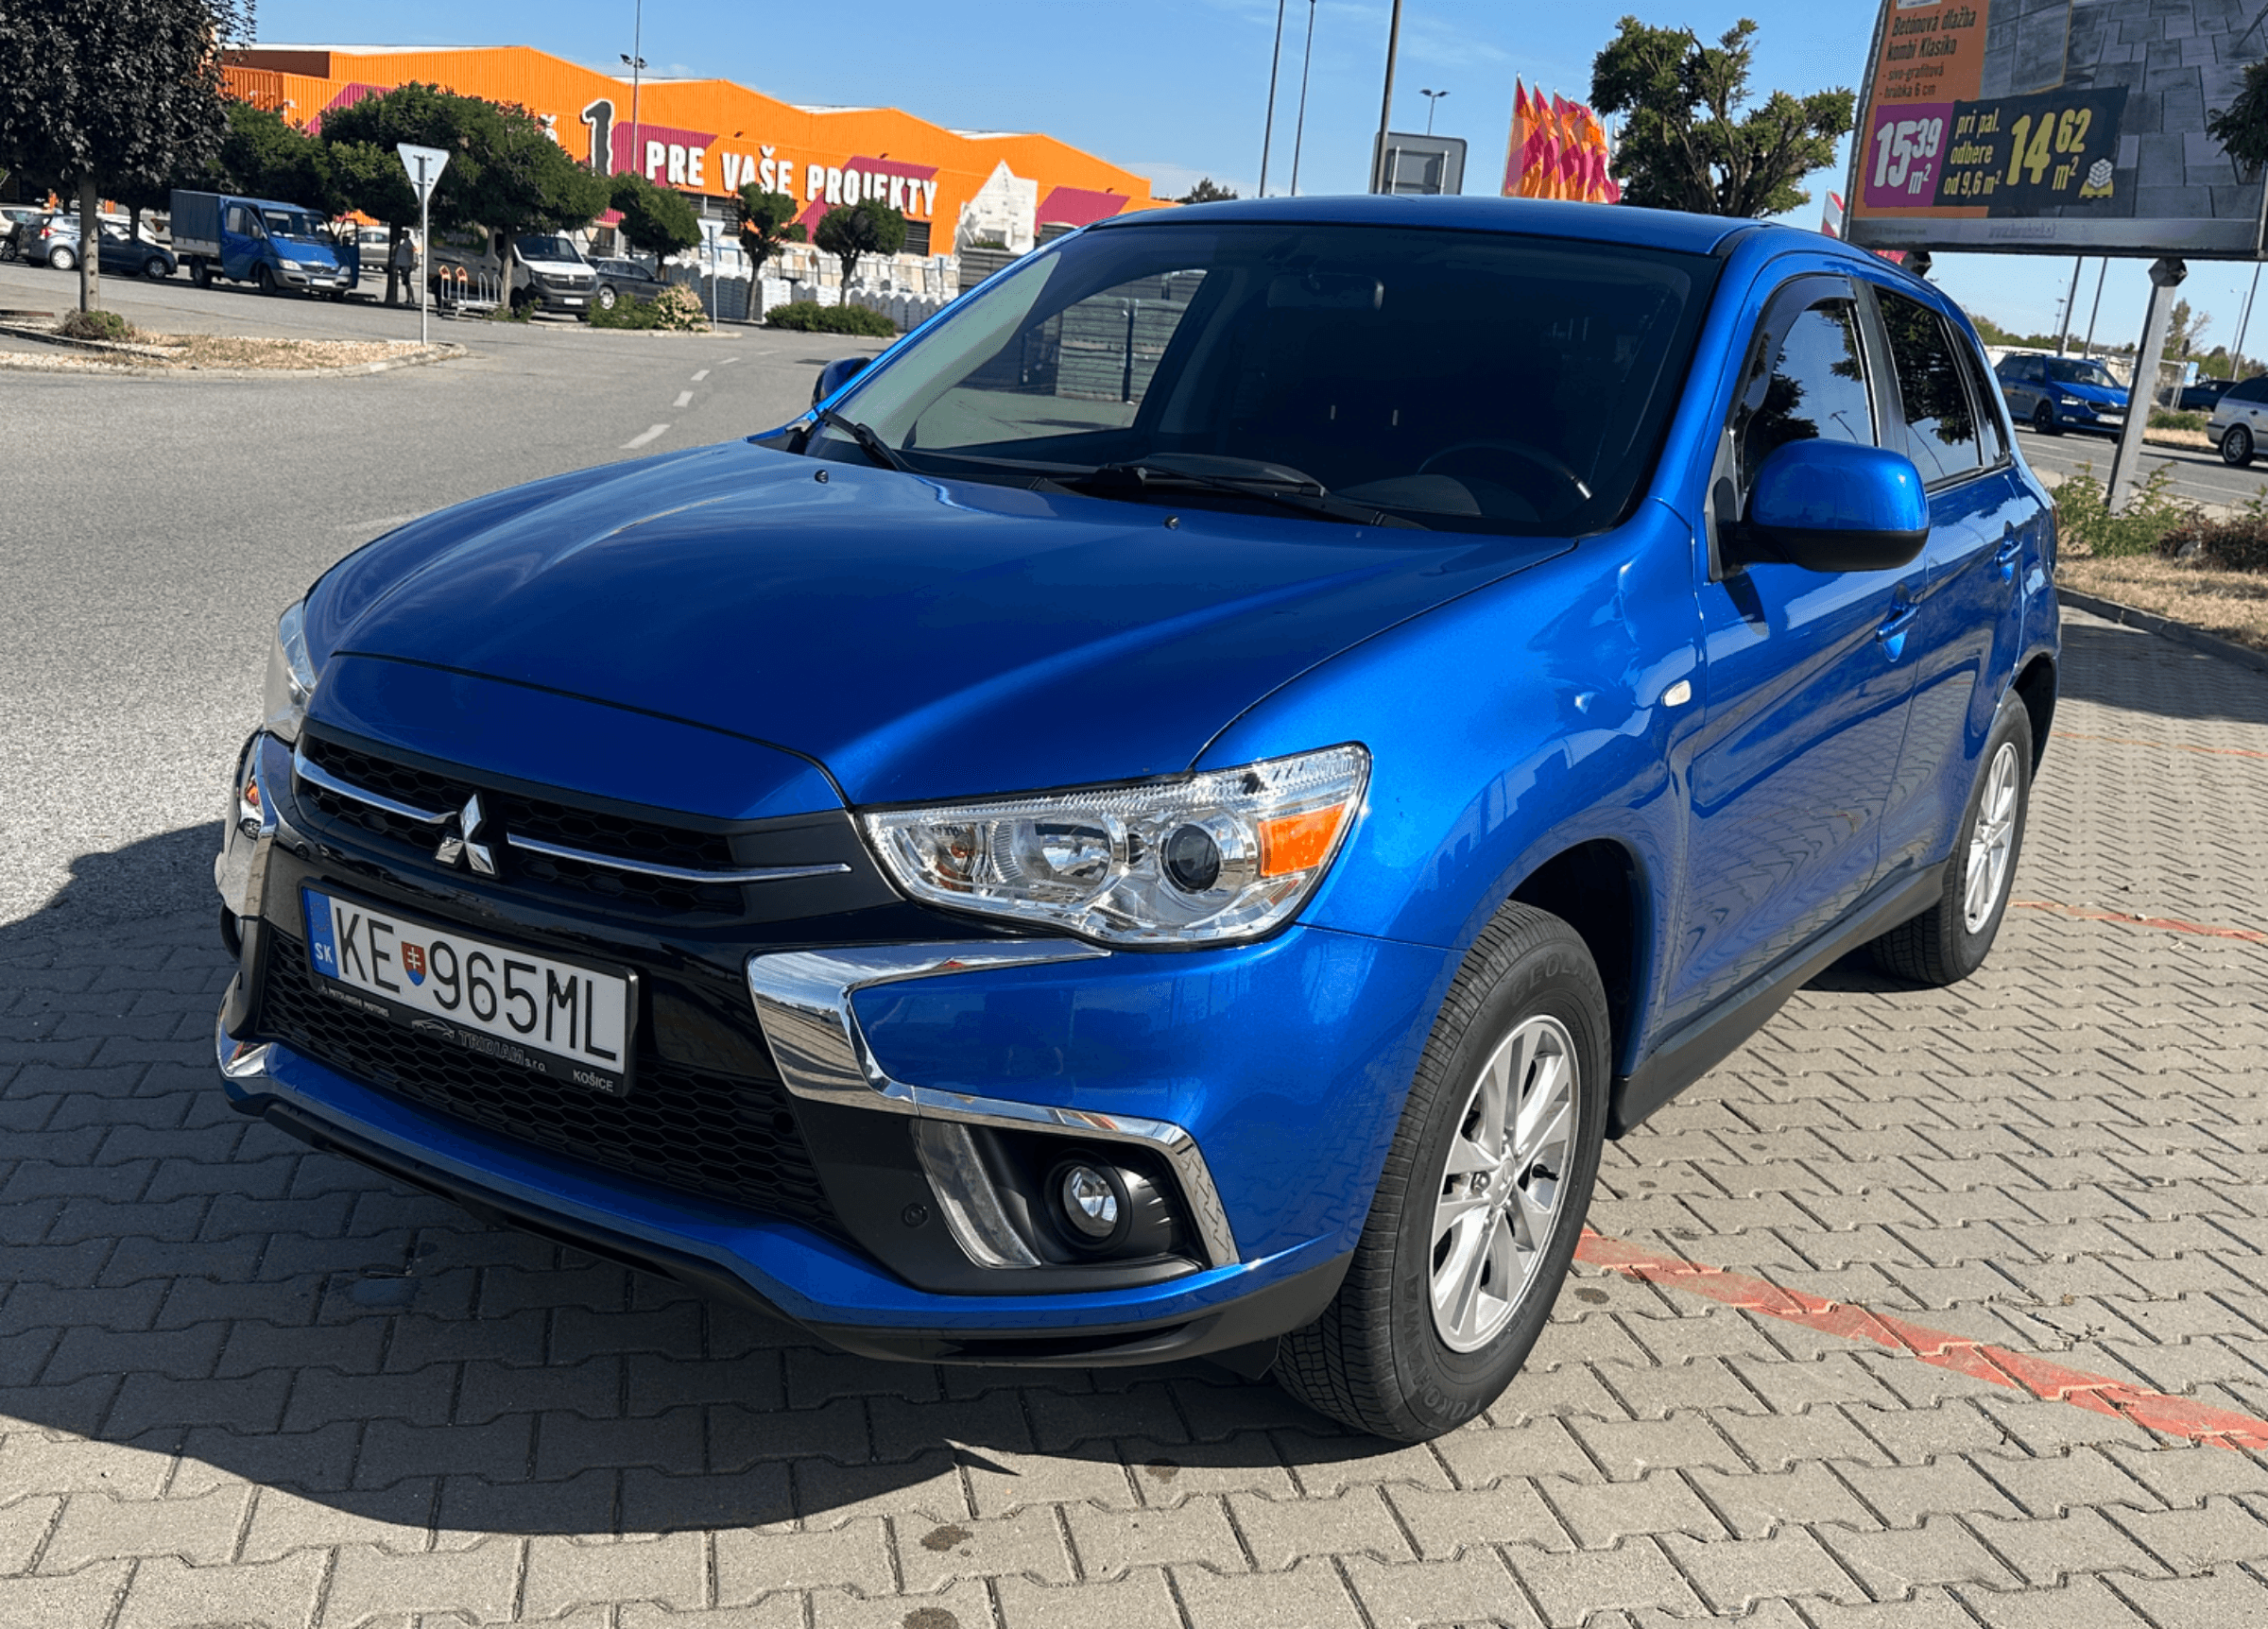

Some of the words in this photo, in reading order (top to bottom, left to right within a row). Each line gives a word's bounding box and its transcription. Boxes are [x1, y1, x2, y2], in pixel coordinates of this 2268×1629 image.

[1955, 109, 1977, 140] pri
[1977, 108, 2000, 139] pal.
[582, 98, 614, 177] 1
[645, 140, 705, 187] PRE
[722, 146, 793, 197] VAŠE
[806, 163, 938, 216] PROJEKTY
[1950, 141, 1994, 164] odbere
[1943, 171, 1961, 195] od
[1961, 171, 1984, 198] 9,6
[315, 941, 333, 964] SK
[335, 907, 401, 993] KE
[429, 941, 617, 1061] 965ML
[573, 1070, 613, 1092] KOŠICE
